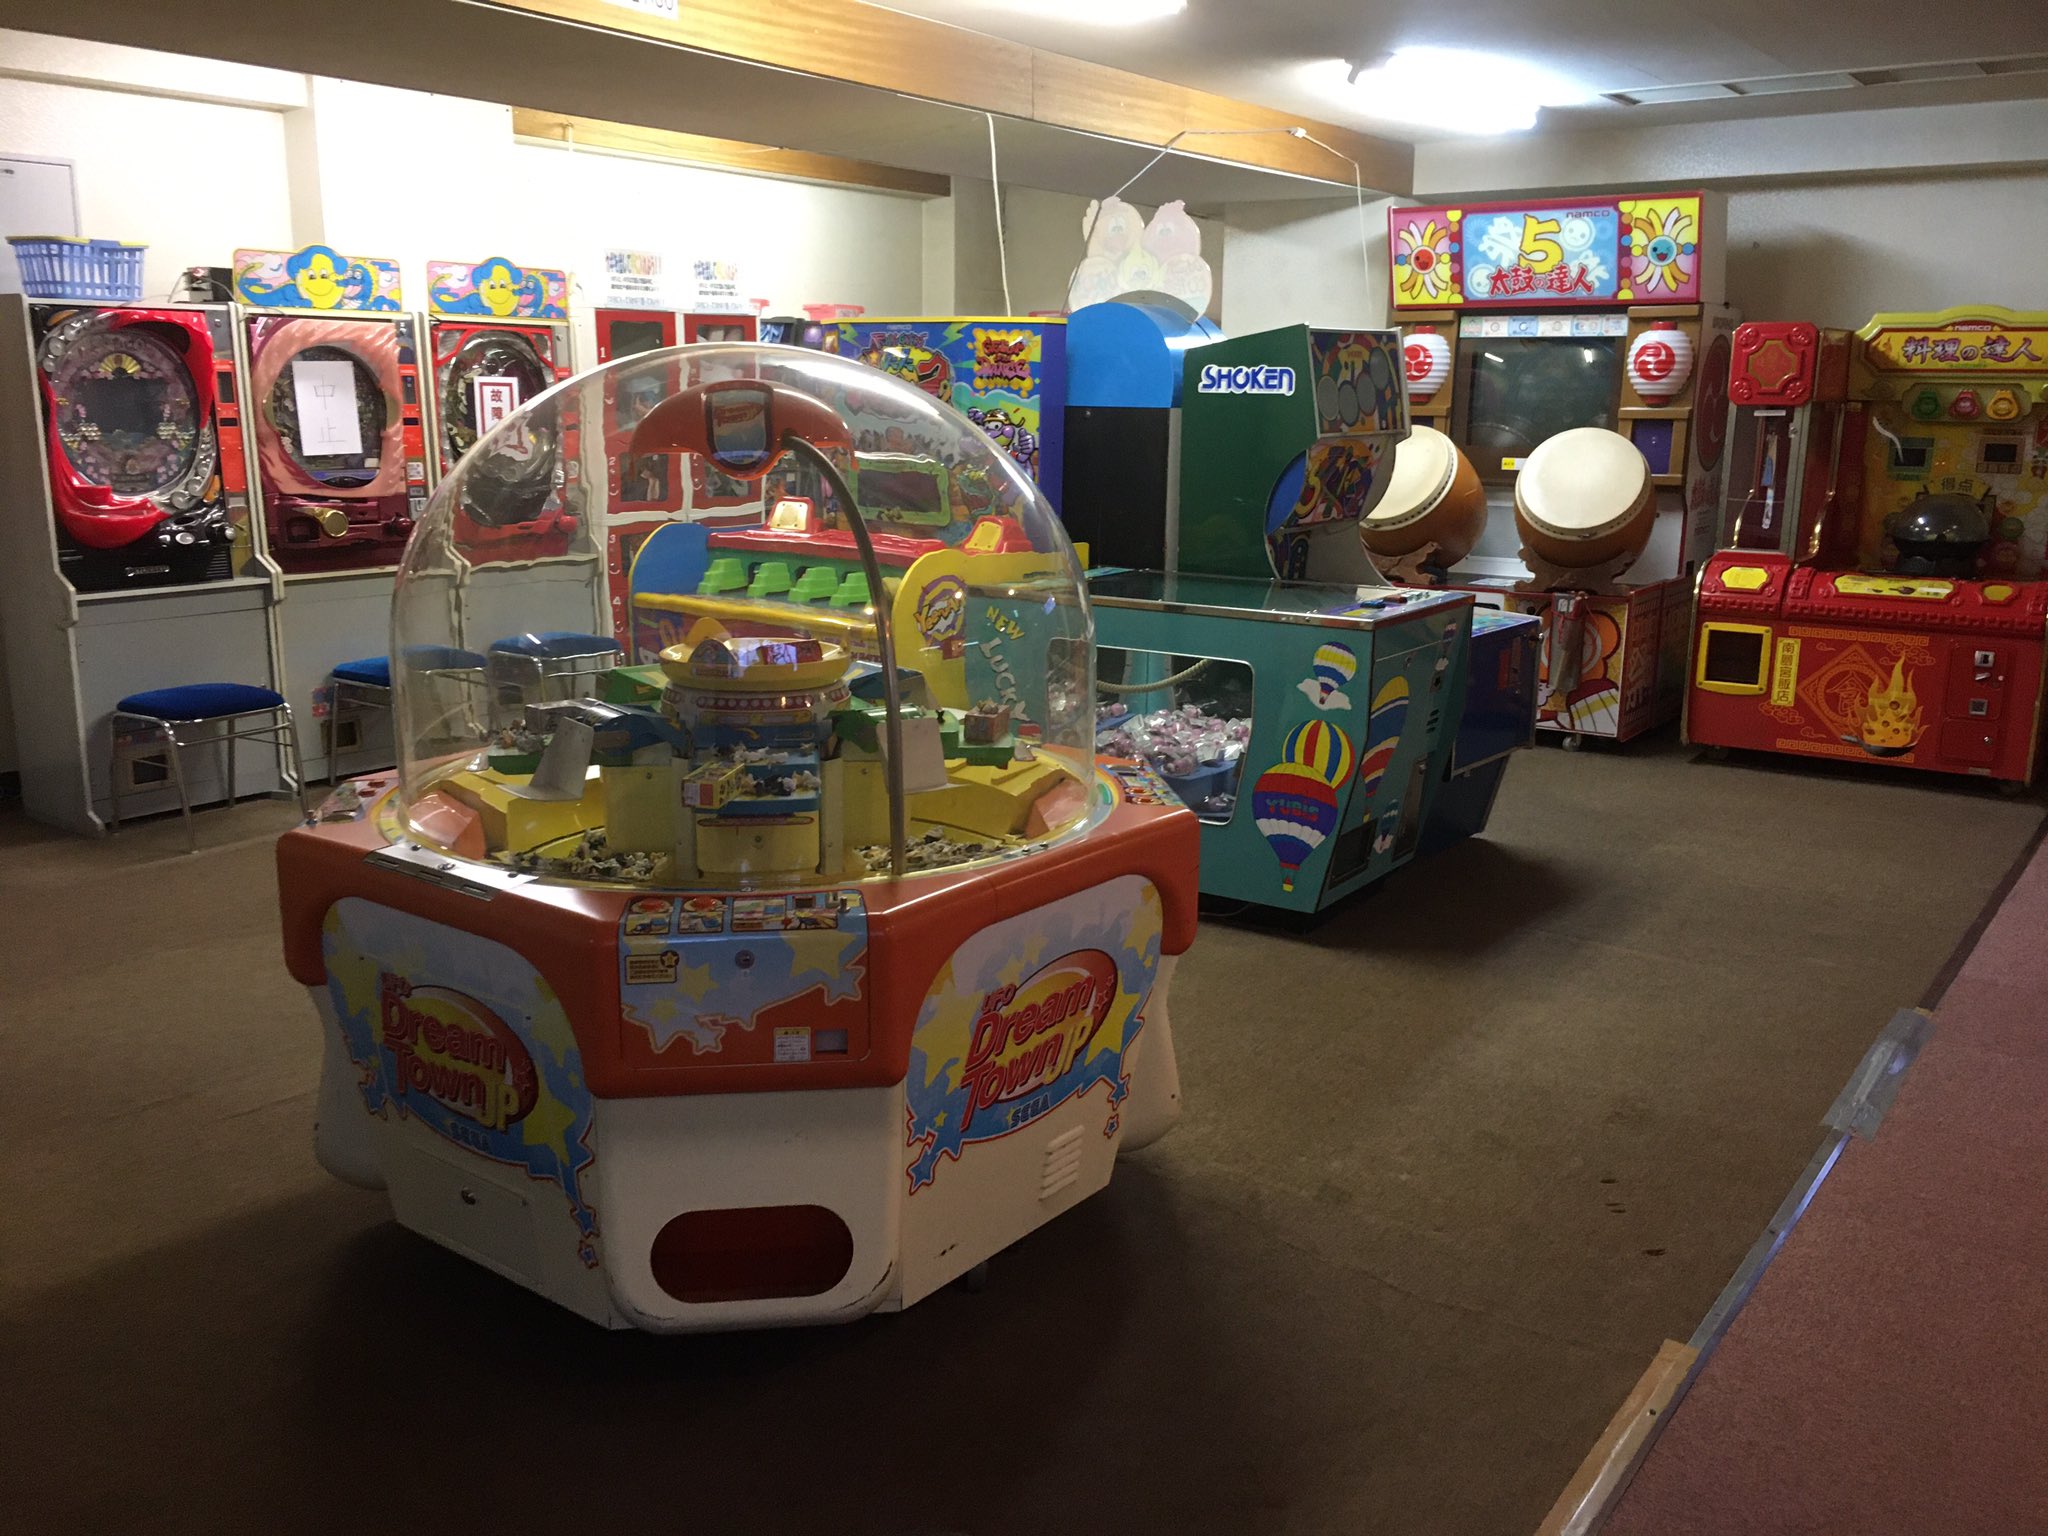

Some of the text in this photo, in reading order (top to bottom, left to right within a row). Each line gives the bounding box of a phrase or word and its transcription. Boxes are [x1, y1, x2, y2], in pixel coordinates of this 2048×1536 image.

[1566, 210, 1610, 219] namco
[1518, 213, 1564, 274] 5
[1489, 263, 1593, 297] 太鼓の達人
[1902, 335, 2042, 364] 料理の達人
[1199, 365, 1295, 395] SHOKEN
[1941, 477, 1974, 492] 得点
[609, 535, 616, 544] 3
[612, 596, 621, 605] 4
[986, 605, 1025, 640] NEW
[982, 983, 1017, 1012] UFO
[381, 988, 507, 1074] Dream
[964, 974, 1095, 1072] Dream
[383, 1037, 487, 1116] Town
[960, 1033, 1065, 1131] Town
[1010, 1094, 1051, 1127] SEGA
